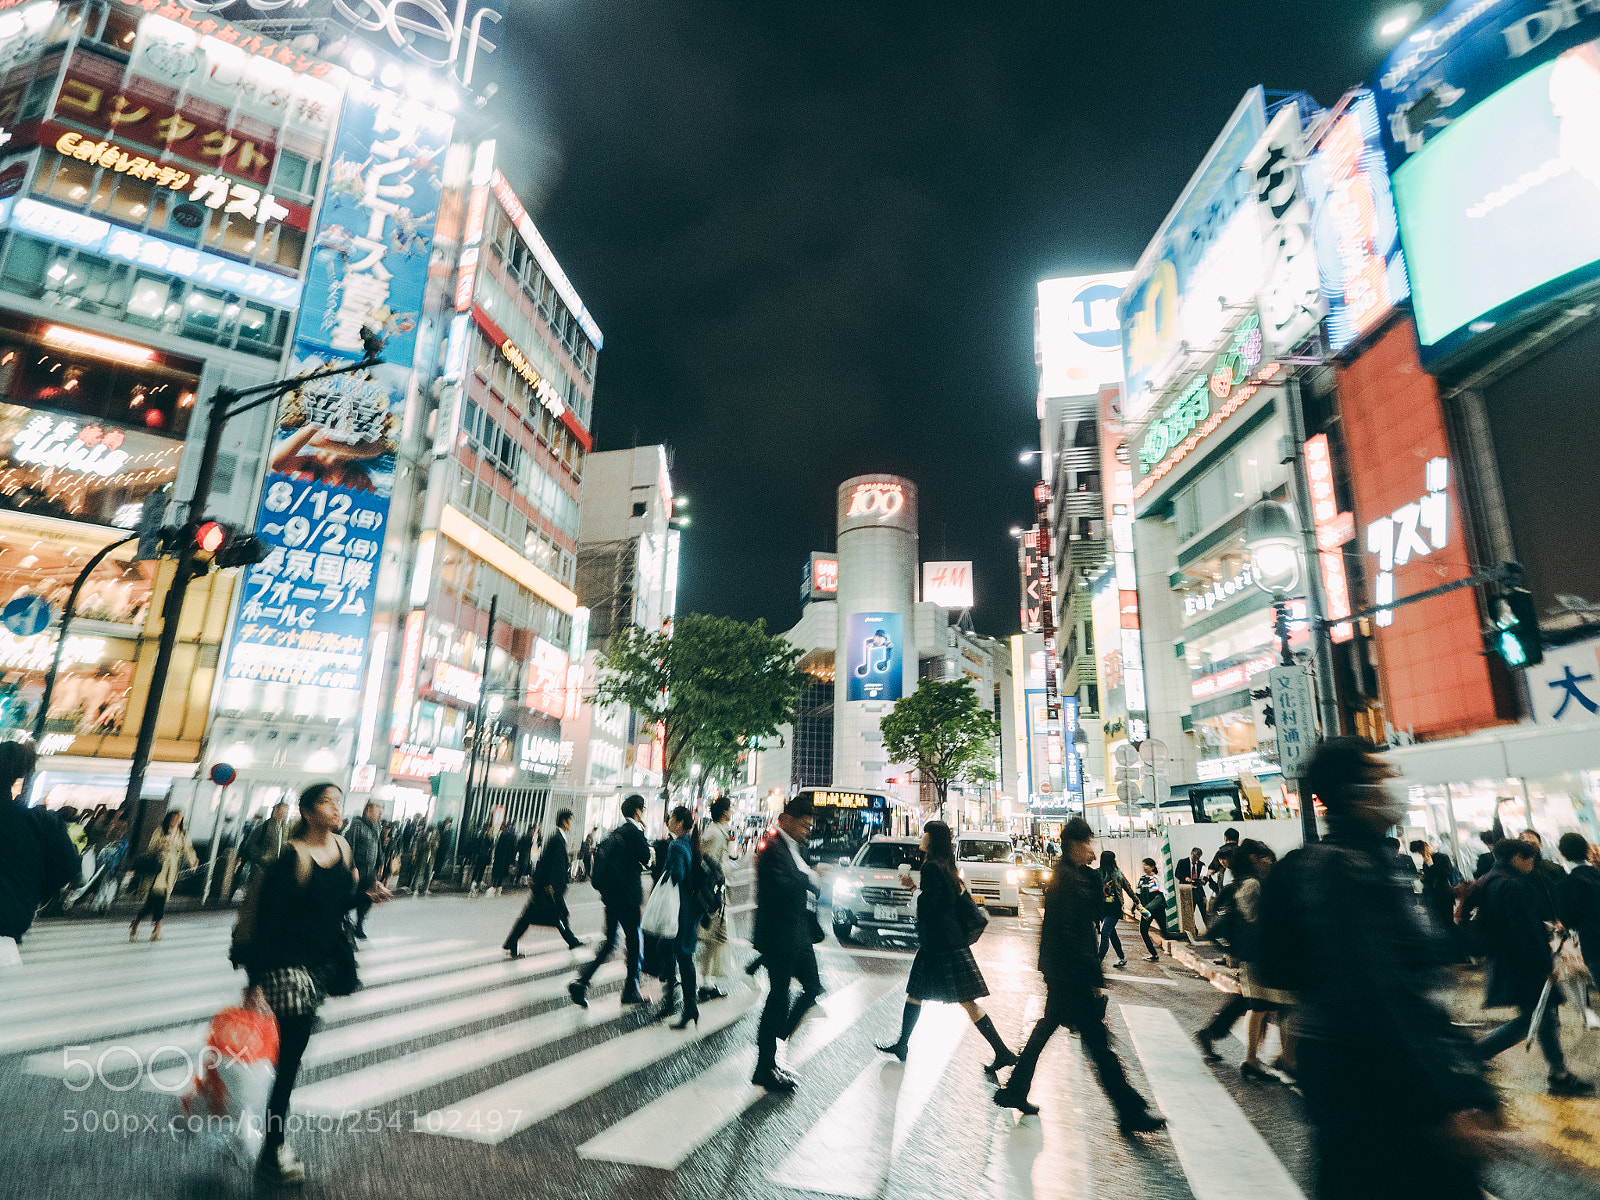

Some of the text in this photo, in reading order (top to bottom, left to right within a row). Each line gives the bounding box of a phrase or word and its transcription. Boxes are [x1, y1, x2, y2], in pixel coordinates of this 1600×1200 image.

[61, 79, 269, 169] コンタクト
[188, 174, 289, 224] ガスト
[846, 490, 904, 520] 109
[250, 545, 373, 590] 東京国際
[240, 597, 316, 629] ホールC
[248, 574, 366, 616] フォーラム
[1277, 675, 1301, 758] 文化村通り
